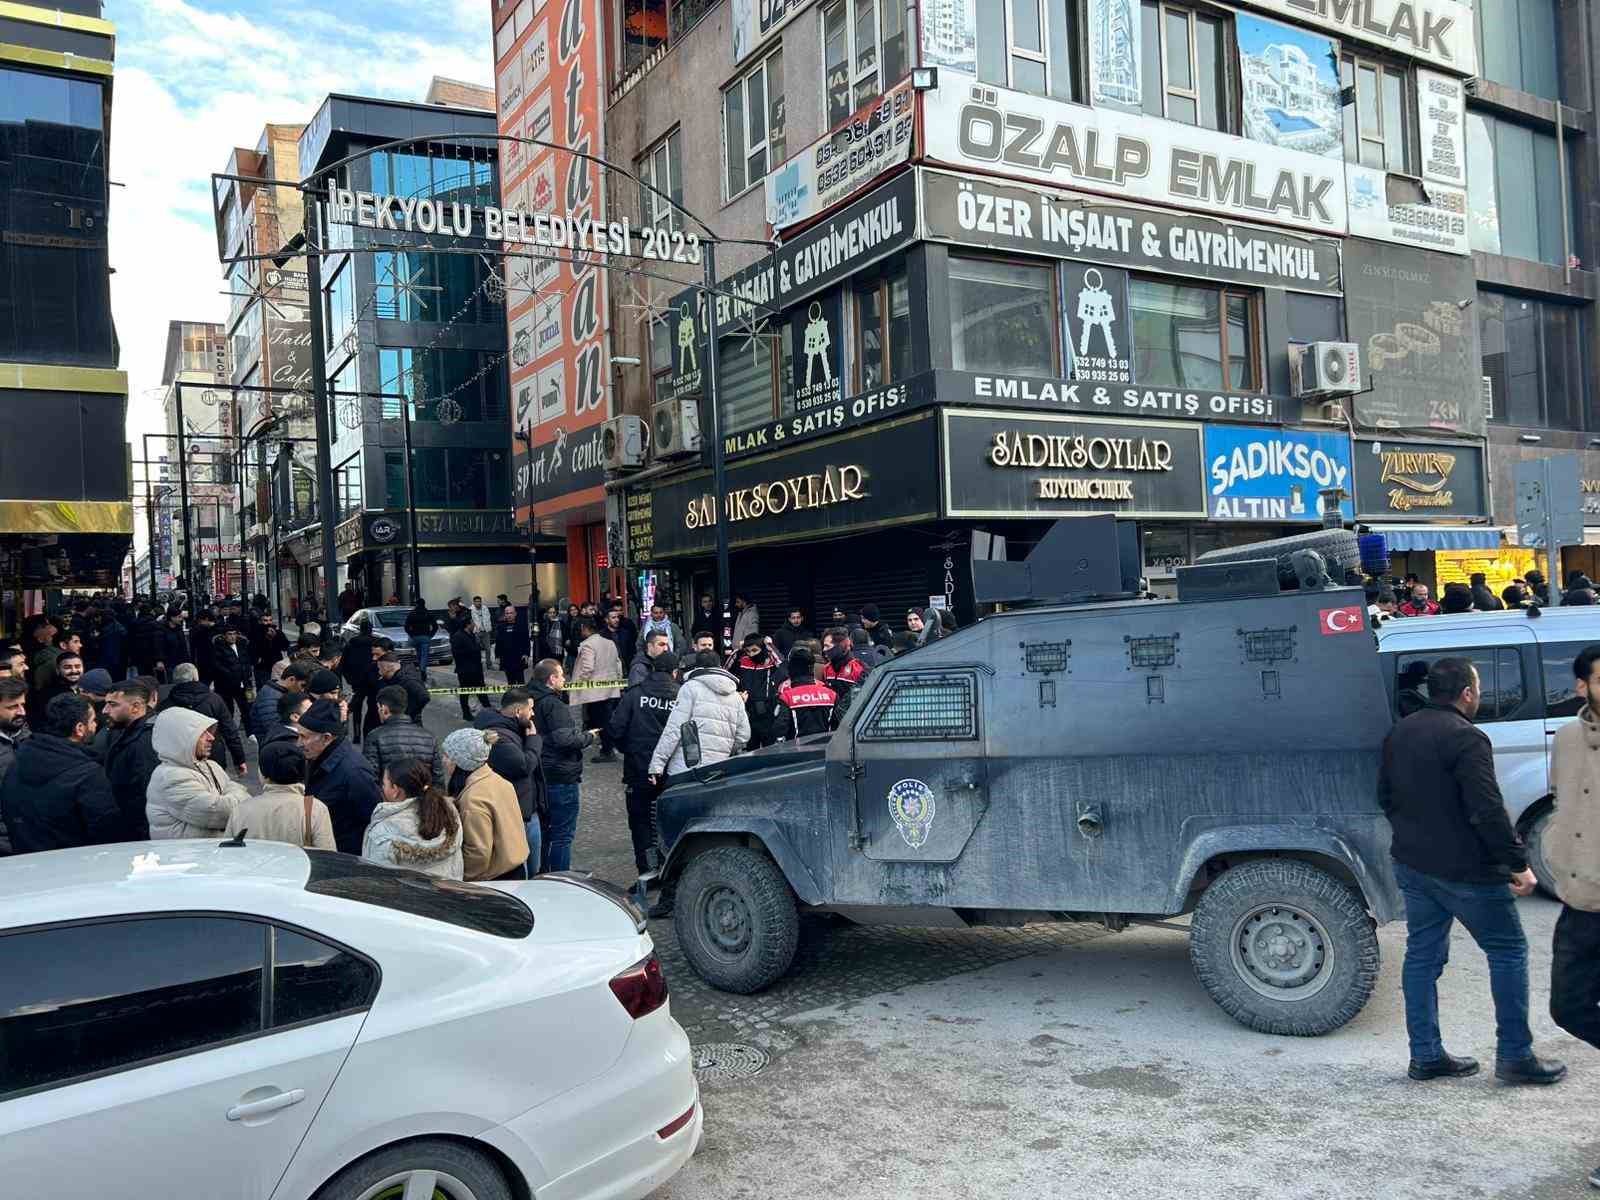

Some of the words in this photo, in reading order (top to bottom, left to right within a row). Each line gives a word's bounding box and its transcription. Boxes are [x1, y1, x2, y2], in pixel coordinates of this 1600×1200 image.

[956, 84, 1150, 187] ÖZALP
[1169, 146, 1335, 224] EMLAK
[328, 178, 472, 238] İPEKYOLU
[485, 208, 631, 256] BELEDİYESİ
[642, 227, 700, 265] 2023
[957, 182, 1033, 239] ÖZER
[1041, 196, 1133, 253] İNŞAAT
[1141, 222, 1161, 257] &
[1168, 222, 1320, 281] GAYRİMENKUL
[780, 260, 792, 294] &
[795, 197, 902, 285] GAYRİMENKUL
[1091, 357, 1106, 368] 749
[1108, 359, 1118, 369] 13
[1120, 360, 1129, 370] 03
[1091, 370, 1106, 381] 935
[975, 377, 1081, 404] EMLAK
[1093, 387, 1111, 405] &
[1123, 390, 1200, 416] SATIŞ
[725, 431, 768, 455] MLAK
[775, 425, 786, 441] &
[792, 404, 845, 436] SATIŞ
[991, 431, 1174, 472] SADIKSOYLAR
[517, 452, 546, 498] sprt
[1039, 478, 1135, 501] KUYUMCULUK
[1211, 440, 1347, 496] SADIKSOY
[1214, 496, 1286, 519] ALTIN
